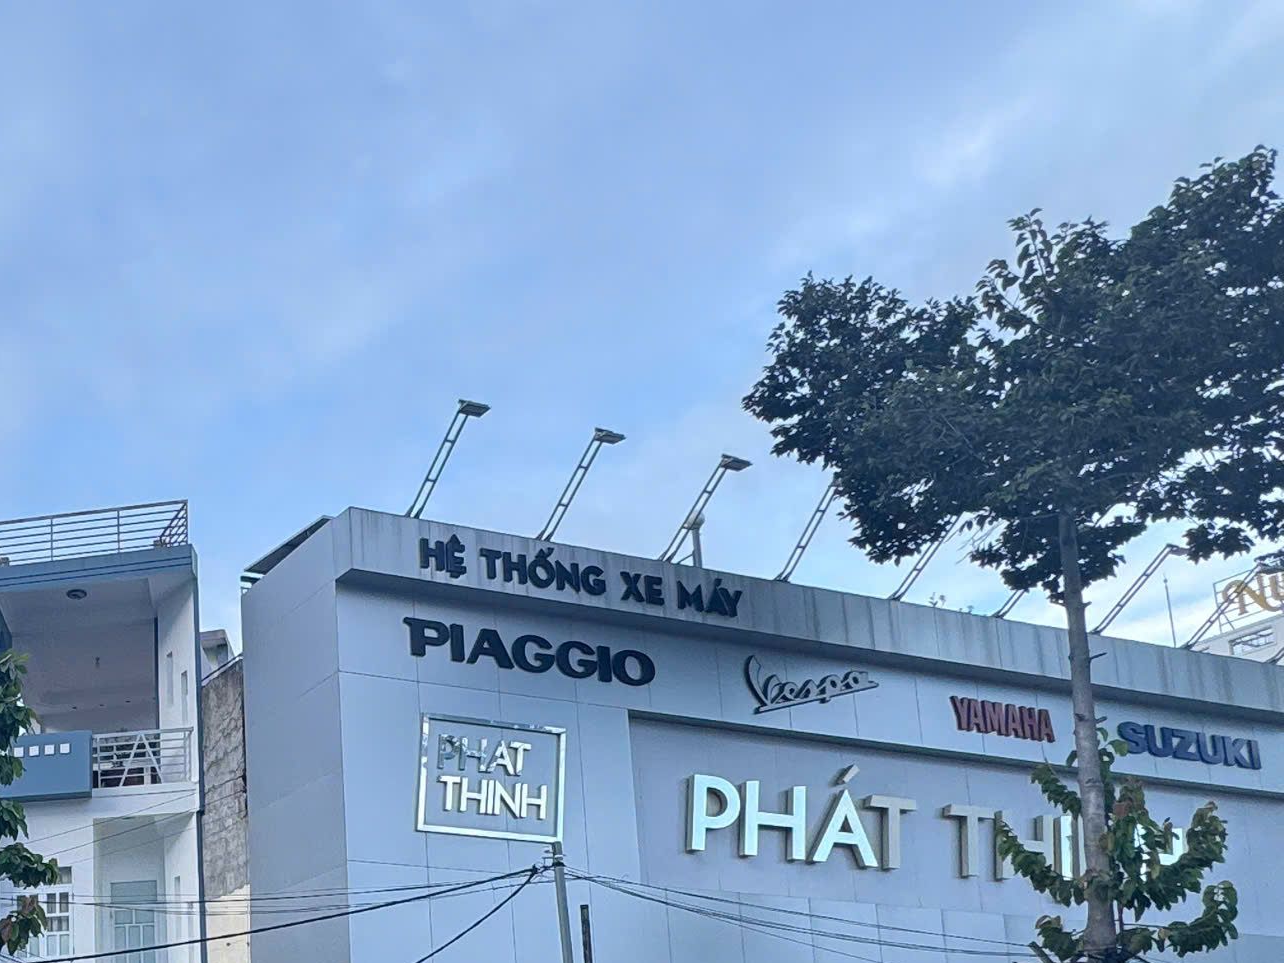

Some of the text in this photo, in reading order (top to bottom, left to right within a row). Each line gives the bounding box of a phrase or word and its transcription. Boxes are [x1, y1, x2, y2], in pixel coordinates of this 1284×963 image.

[419, 535, 743, 619] HỆ THỐNG XE MÁY
[403, 616, 656, 687] PIAGGIO
[743, 654, 880, 715] Vespa
[949, 695, 1056, 743] YAMAHA
[1116, 721, 1262, 771] SUZUKI
[685, 763, 916, 871] PHÁT
